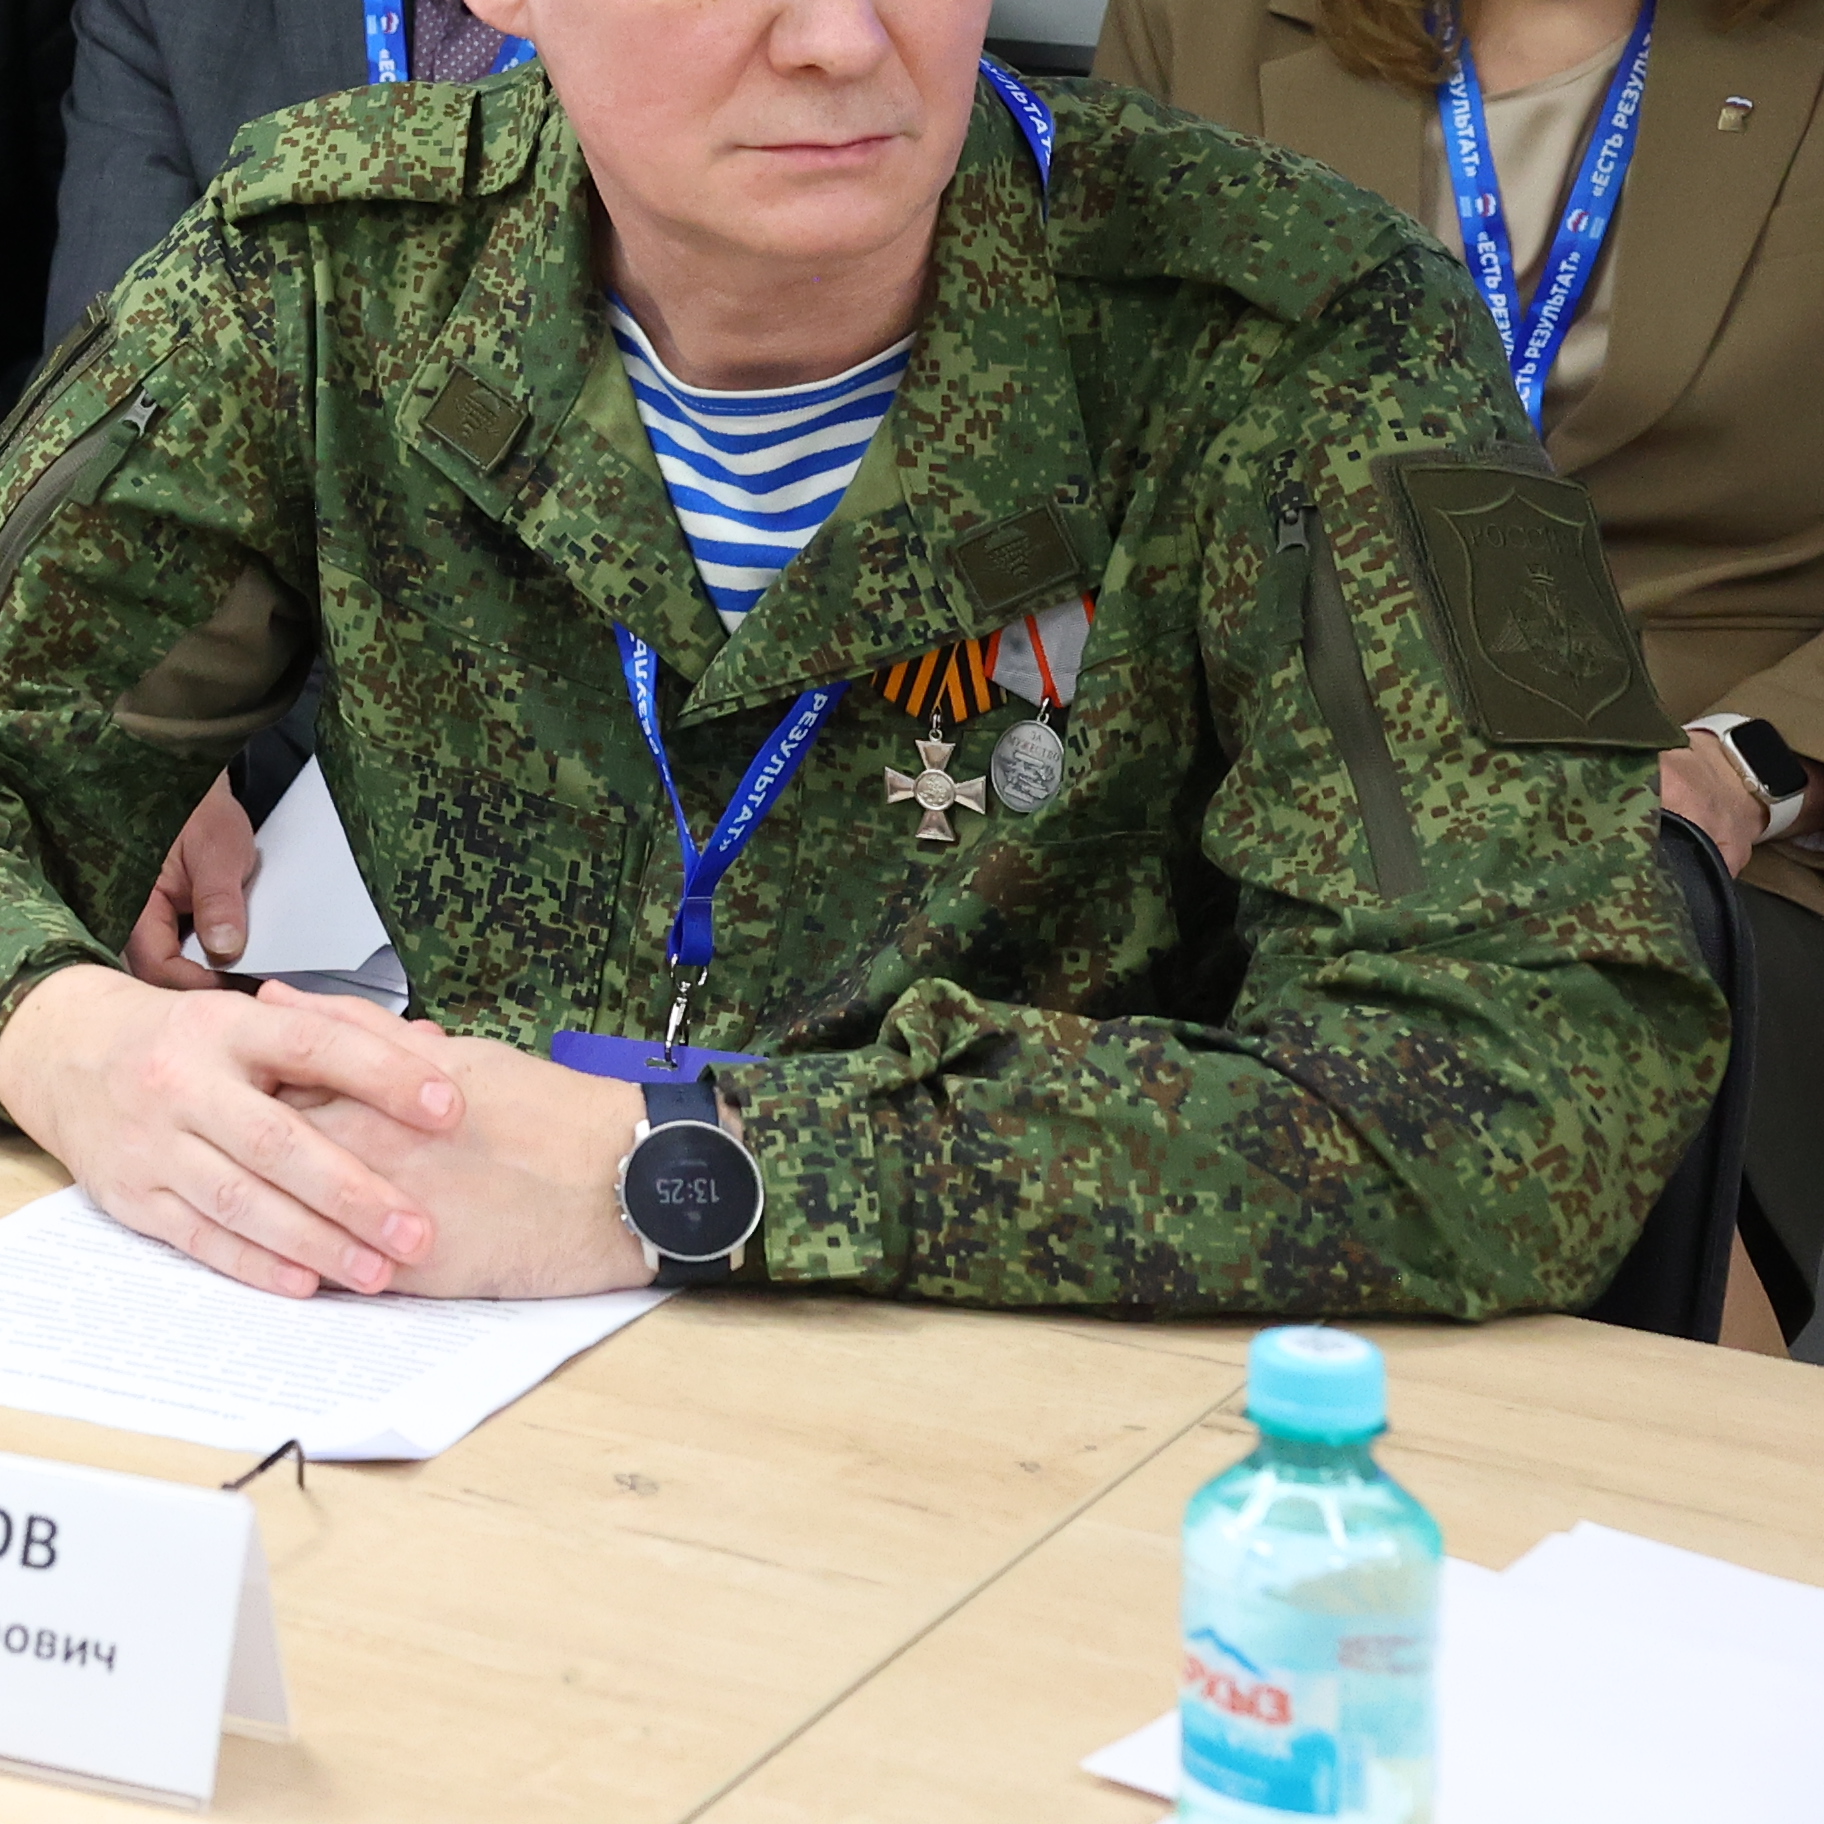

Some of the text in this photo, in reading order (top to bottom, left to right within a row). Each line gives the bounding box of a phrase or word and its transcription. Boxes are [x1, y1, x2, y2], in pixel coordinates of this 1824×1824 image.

[1524, 250, 1582, 359] РЕЗУЛЬТАТ»
[718, 692, 830, 853] РЕЗУЛЬТАТ»
[655, 1177, 721, 1204] 13:25
